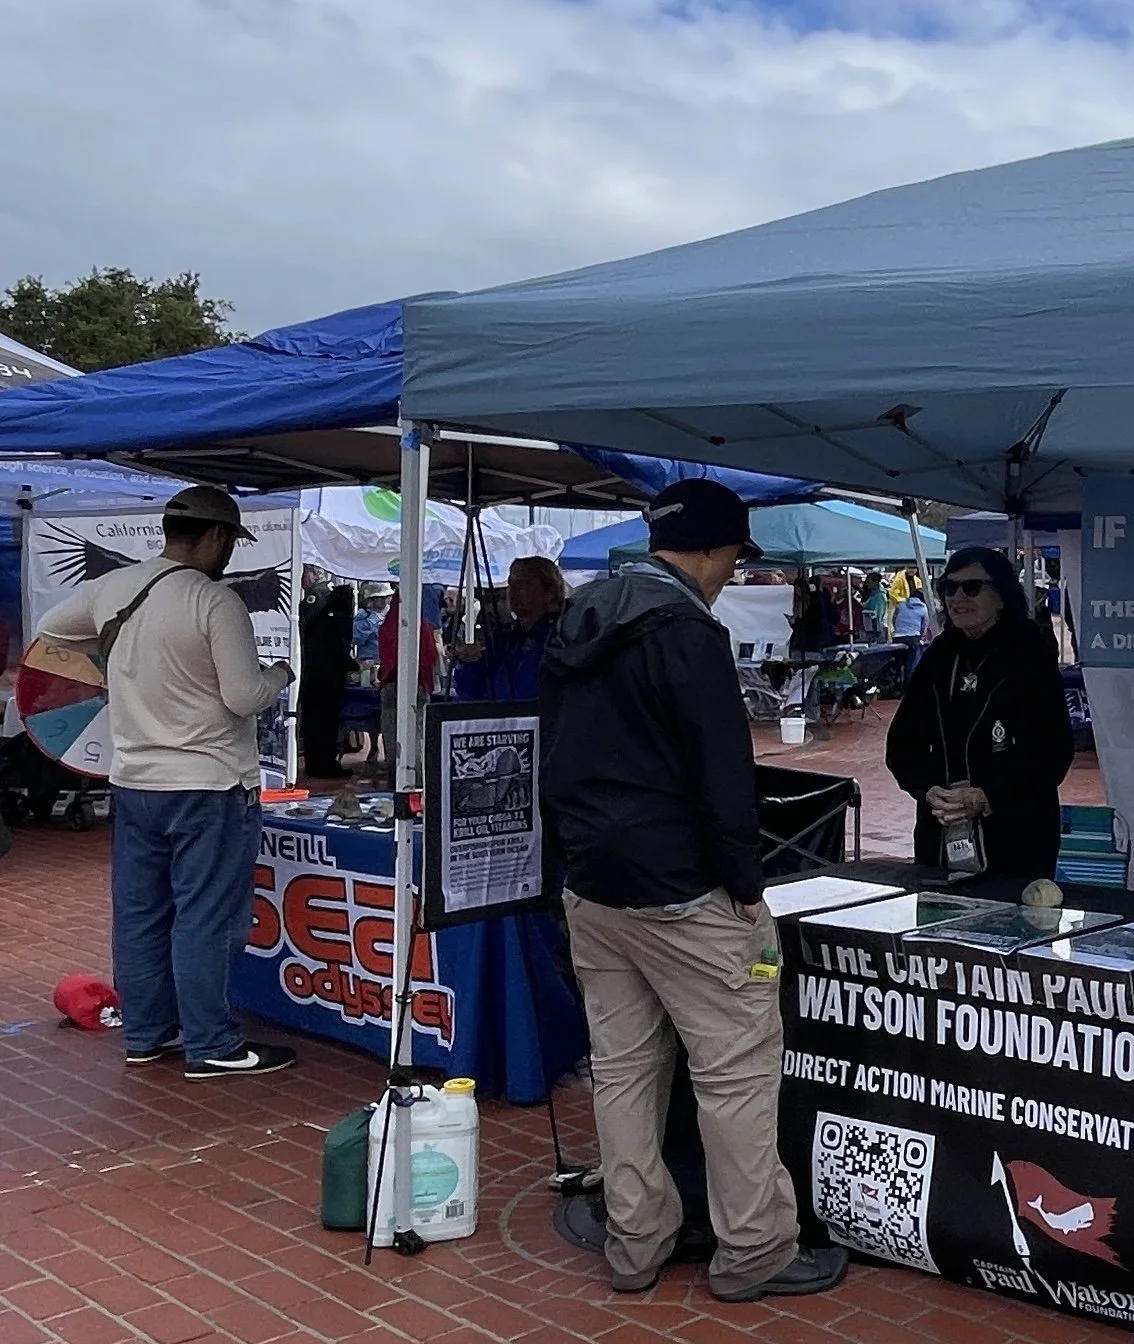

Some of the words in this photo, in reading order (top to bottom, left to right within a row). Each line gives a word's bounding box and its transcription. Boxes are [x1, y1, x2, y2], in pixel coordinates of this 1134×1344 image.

[1092, 515, 1127, 549] IF
[1090, 633, 1107, 650] A
[453, 737, 467, 749] WE
[469, 735, 485, 748] ARE
[486, 733, 530, 746] STARVING
[260, 830, 334, 867] NEILL
[797, 973, 926, 1042] WATSON
[782, 1049, 852, 1087] DIRECT
[853, 1063, 926, 1104] ACTION
[929, 1078, 1006, 1122] MARINE
[977, 1267, 1038, 1295] Paul
